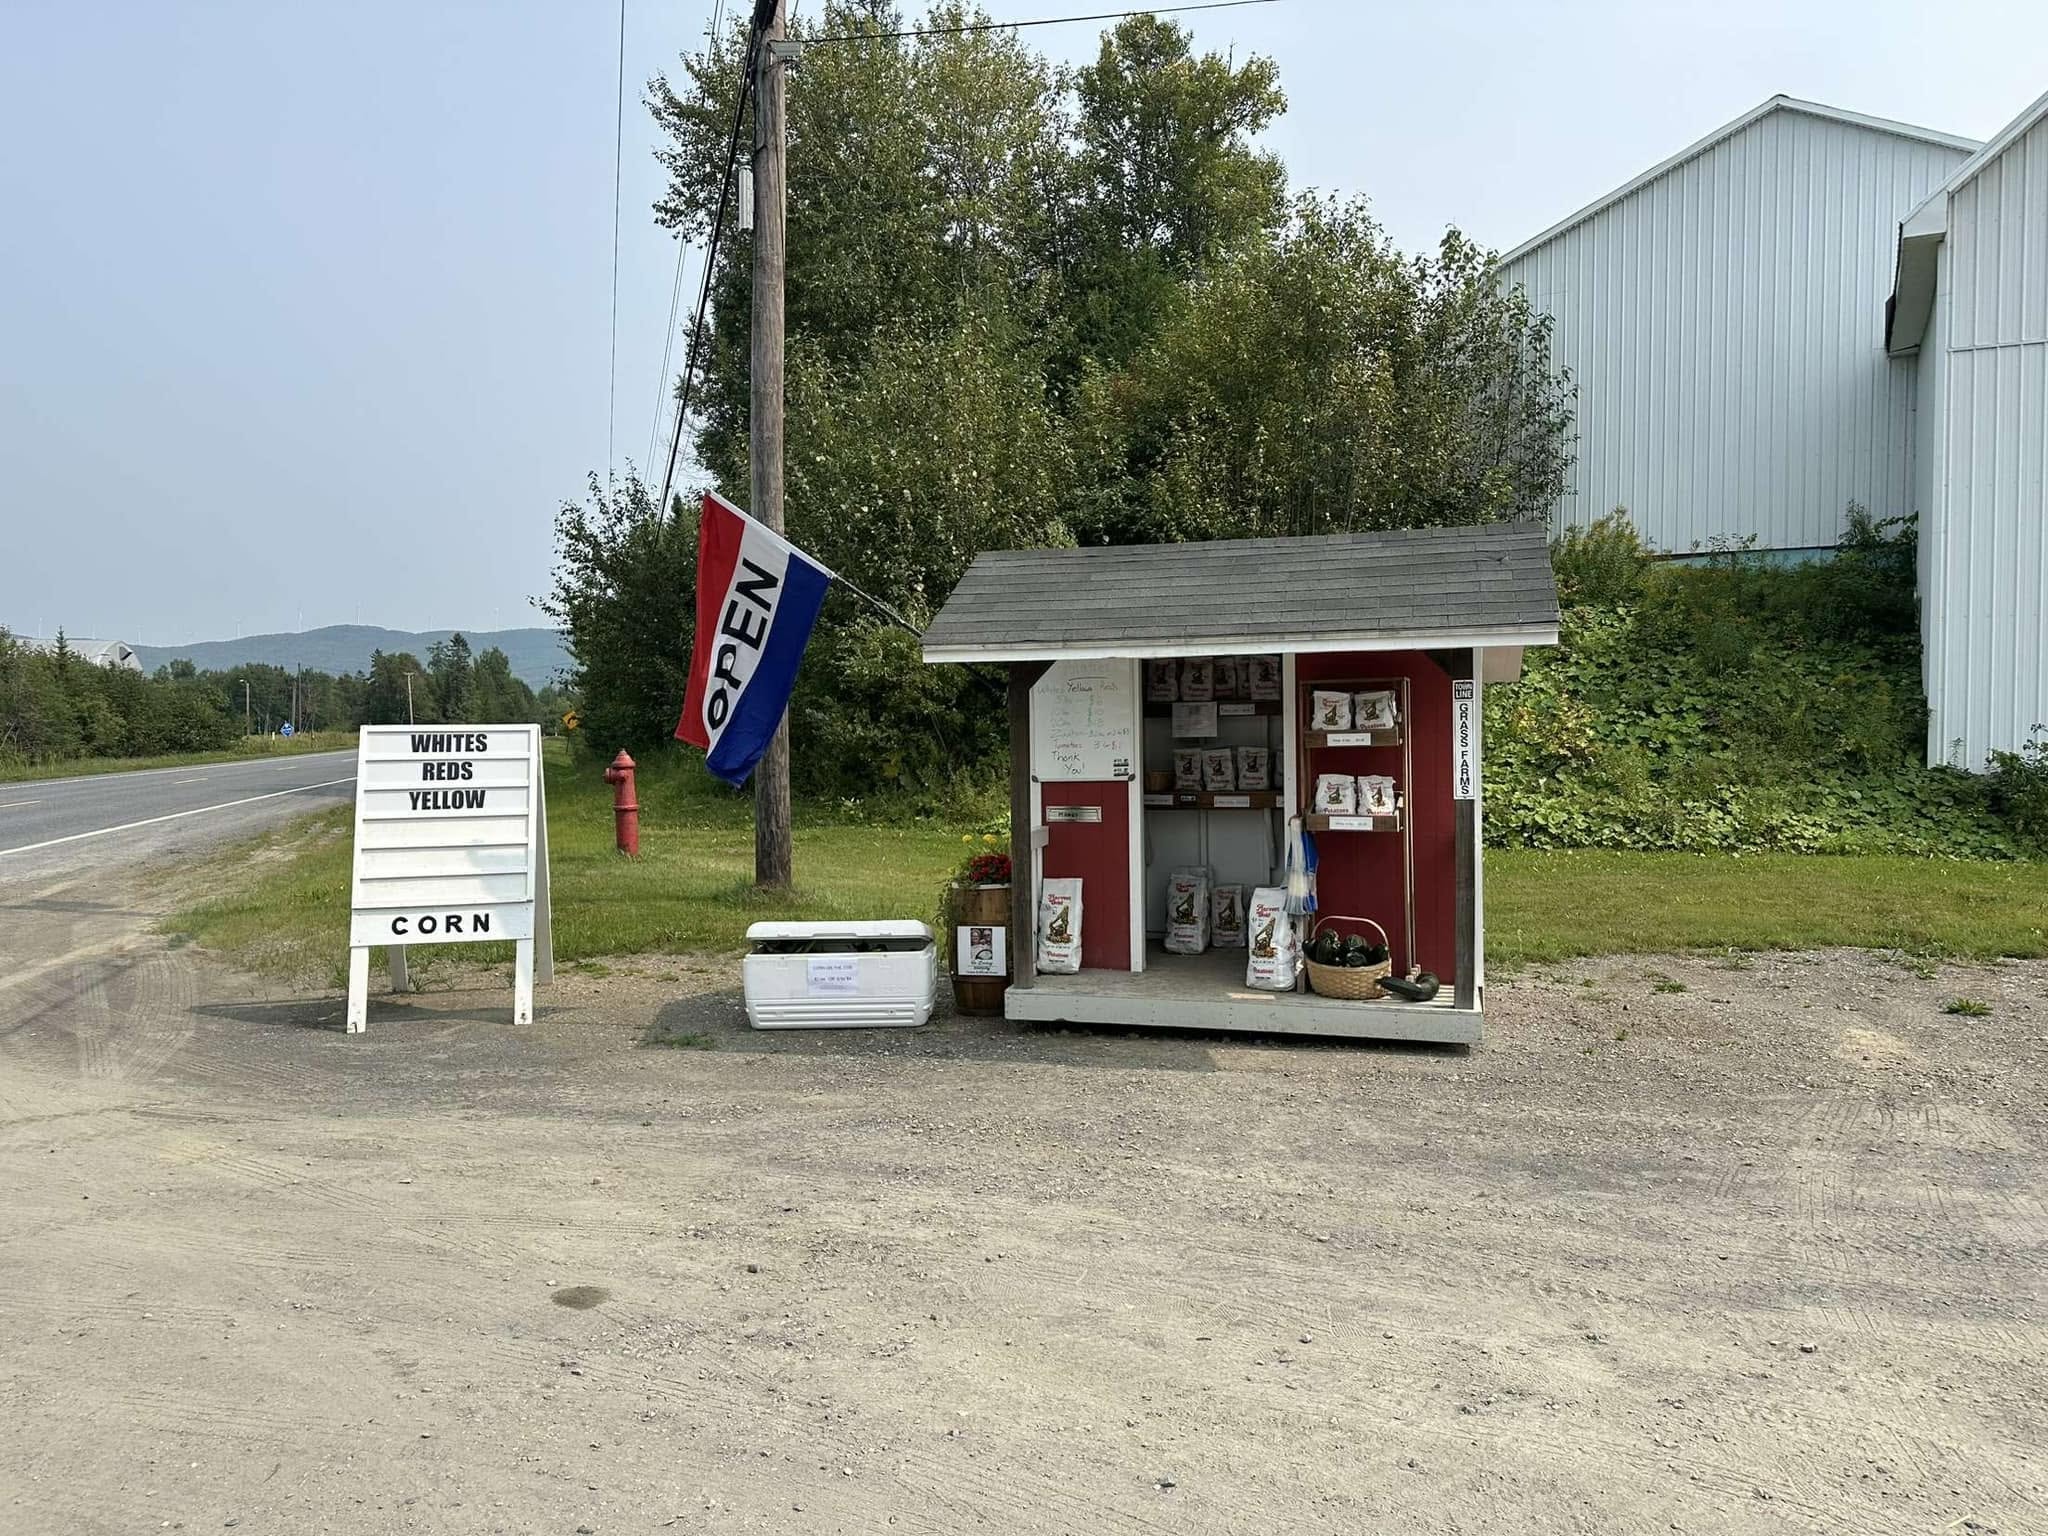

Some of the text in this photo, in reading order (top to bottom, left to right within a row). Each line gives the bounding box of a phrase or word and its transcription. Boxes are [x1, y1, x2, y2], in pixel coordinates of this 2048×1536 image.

[707, 557, 780, 730] OPEN
[1456, 690, 1473, 698] LINE
[411, 733, 488, 753] WHITES
[1460, 703, 1470, 795] GRASS FARMS
[422, 761, 473, 781] REDS
[409, 790, 486, 810] YELLOW
[391, 913, 490, 935] CORN
